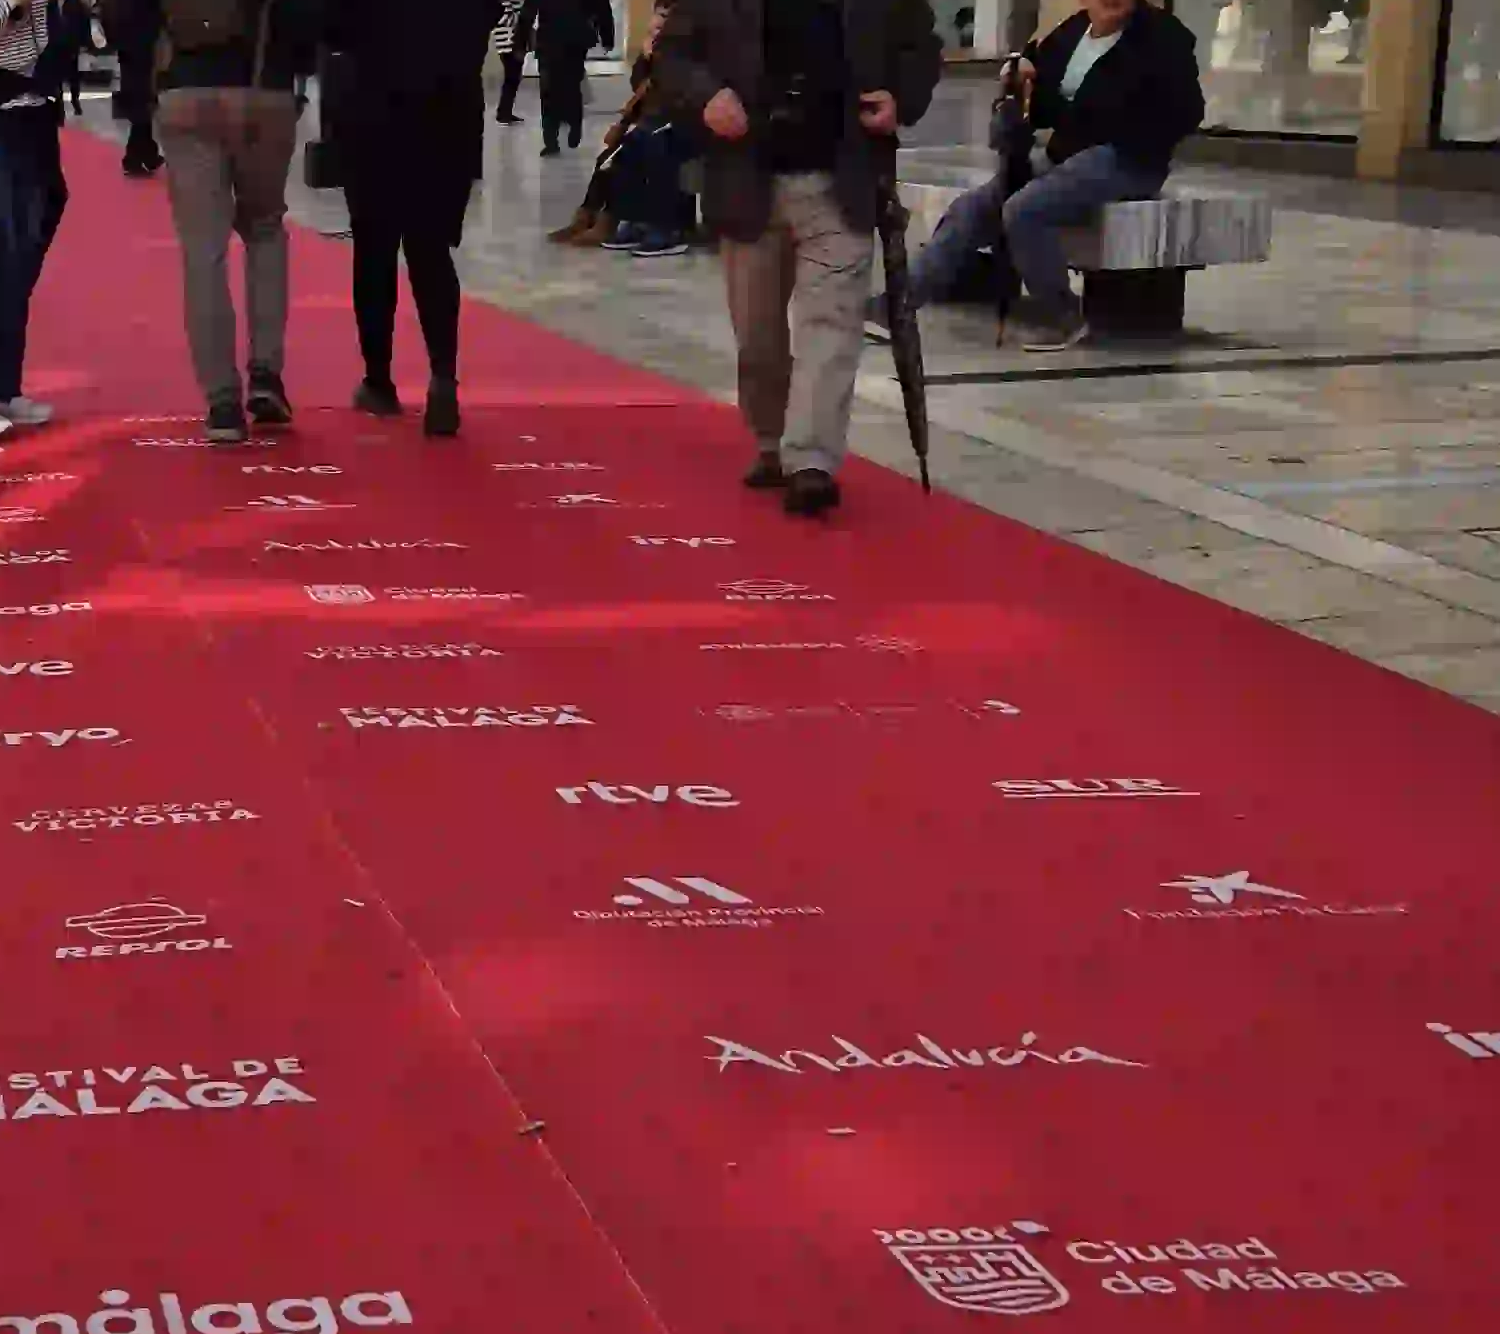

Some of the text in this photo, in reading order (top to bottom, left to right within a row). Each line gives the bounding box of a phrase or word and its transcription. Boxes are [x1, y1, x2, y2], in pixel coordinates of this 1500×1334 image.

[555, 781, 742, 808] rtve
[991, 778, 1184, 795] SUR
[11, 809, 263, 832] VICTORIA
[30, 798, 235, 819] CERVEZAS
[55, 937, 234, 959] REPSOL
[704, 1030, 1150, 1074] Andalucía
[232, 1055, 306, 1079] DE
[1066, 1236, 1279, 1265] Ciudad
[1101, 1267, 1408, 1296] de Málaga
